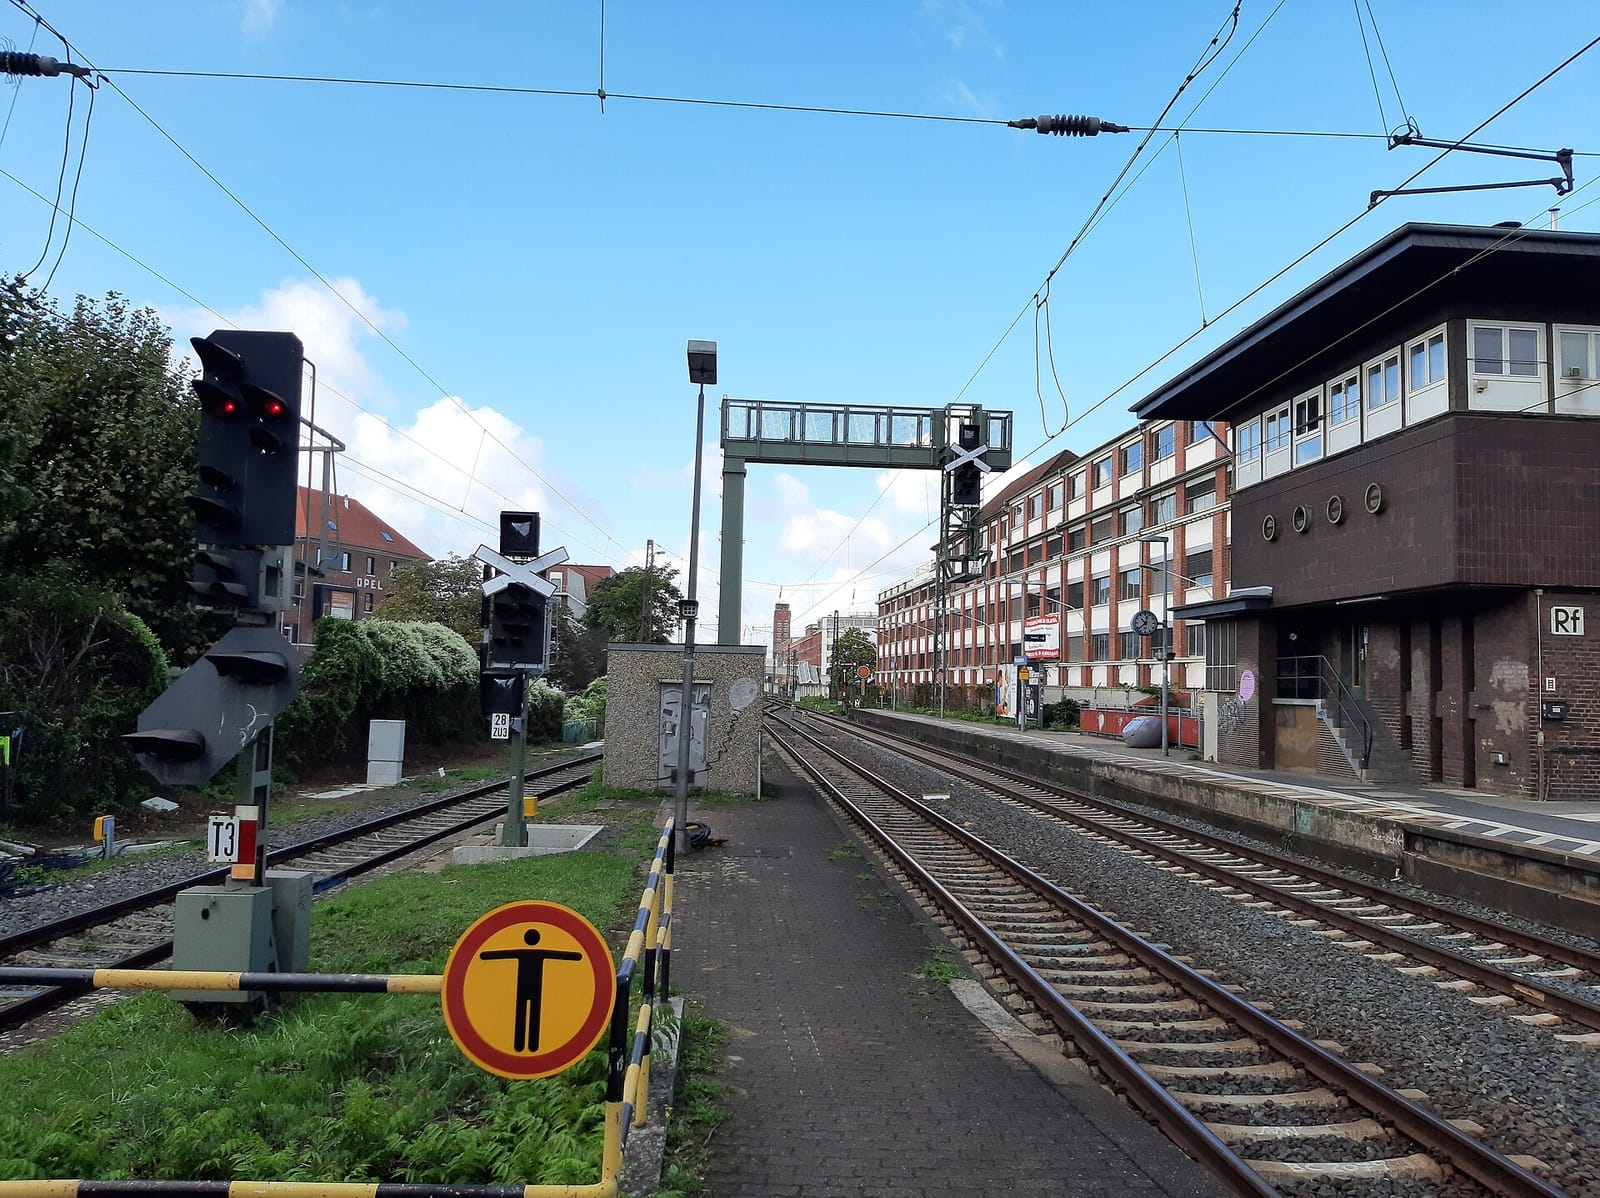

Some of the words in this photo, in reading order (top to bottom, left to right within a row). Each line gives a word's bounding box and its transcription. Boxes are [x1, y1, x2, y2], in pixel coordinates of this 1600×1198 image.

[356, 577, 383, 590] OPEL
[1555, 608, 1580, 633] Rf
[495, 714, 507, 725] 28
[212, 821, 235, 857] T3
